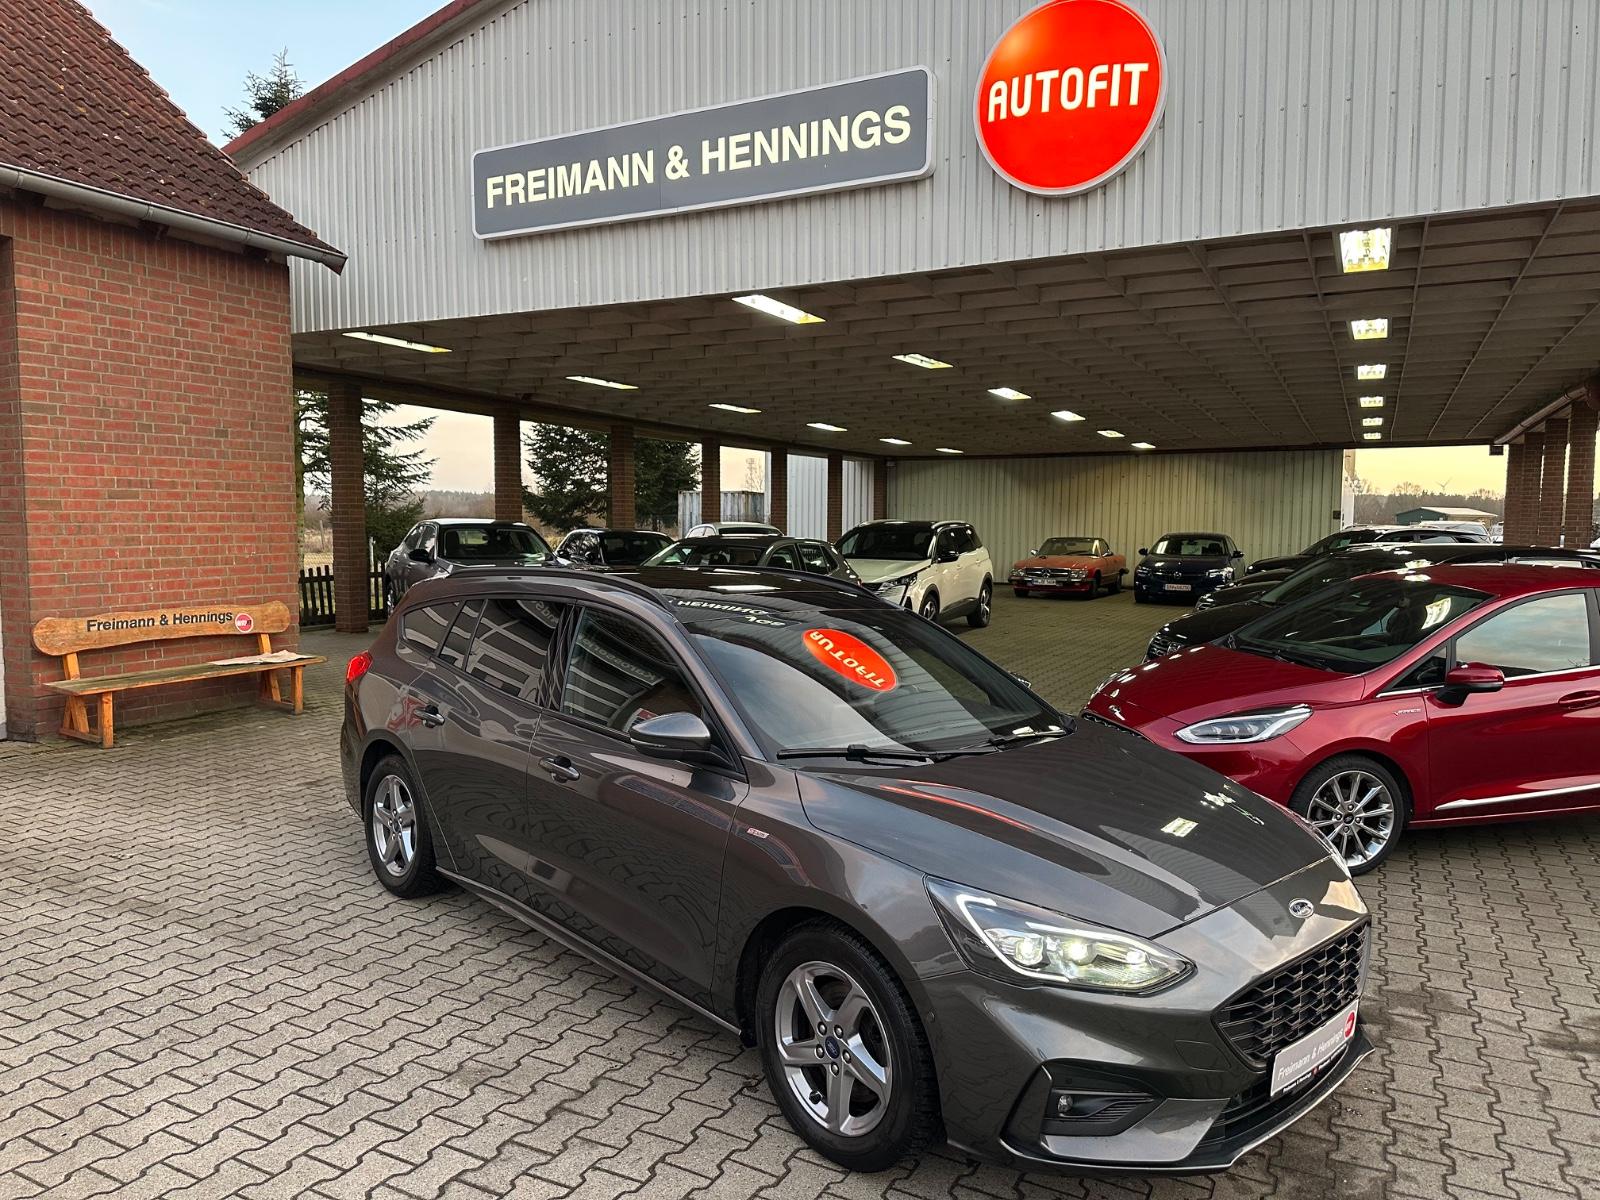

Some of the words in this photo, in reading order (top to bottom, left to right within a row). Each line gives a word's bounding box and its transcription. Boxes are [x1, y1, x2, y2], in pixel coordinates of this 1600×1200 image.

[986, 62, 1150, 122] AUTOFIT
[486, 149, 655, 209] FREIMANN
[664, 145, 690, 181] &
[701, 105, 912, 175] HENNINGS
[86, 618, 155, 632] Freimann
[159, 614, 170, 626] &
[173, 611, 233, 624] Hennings
